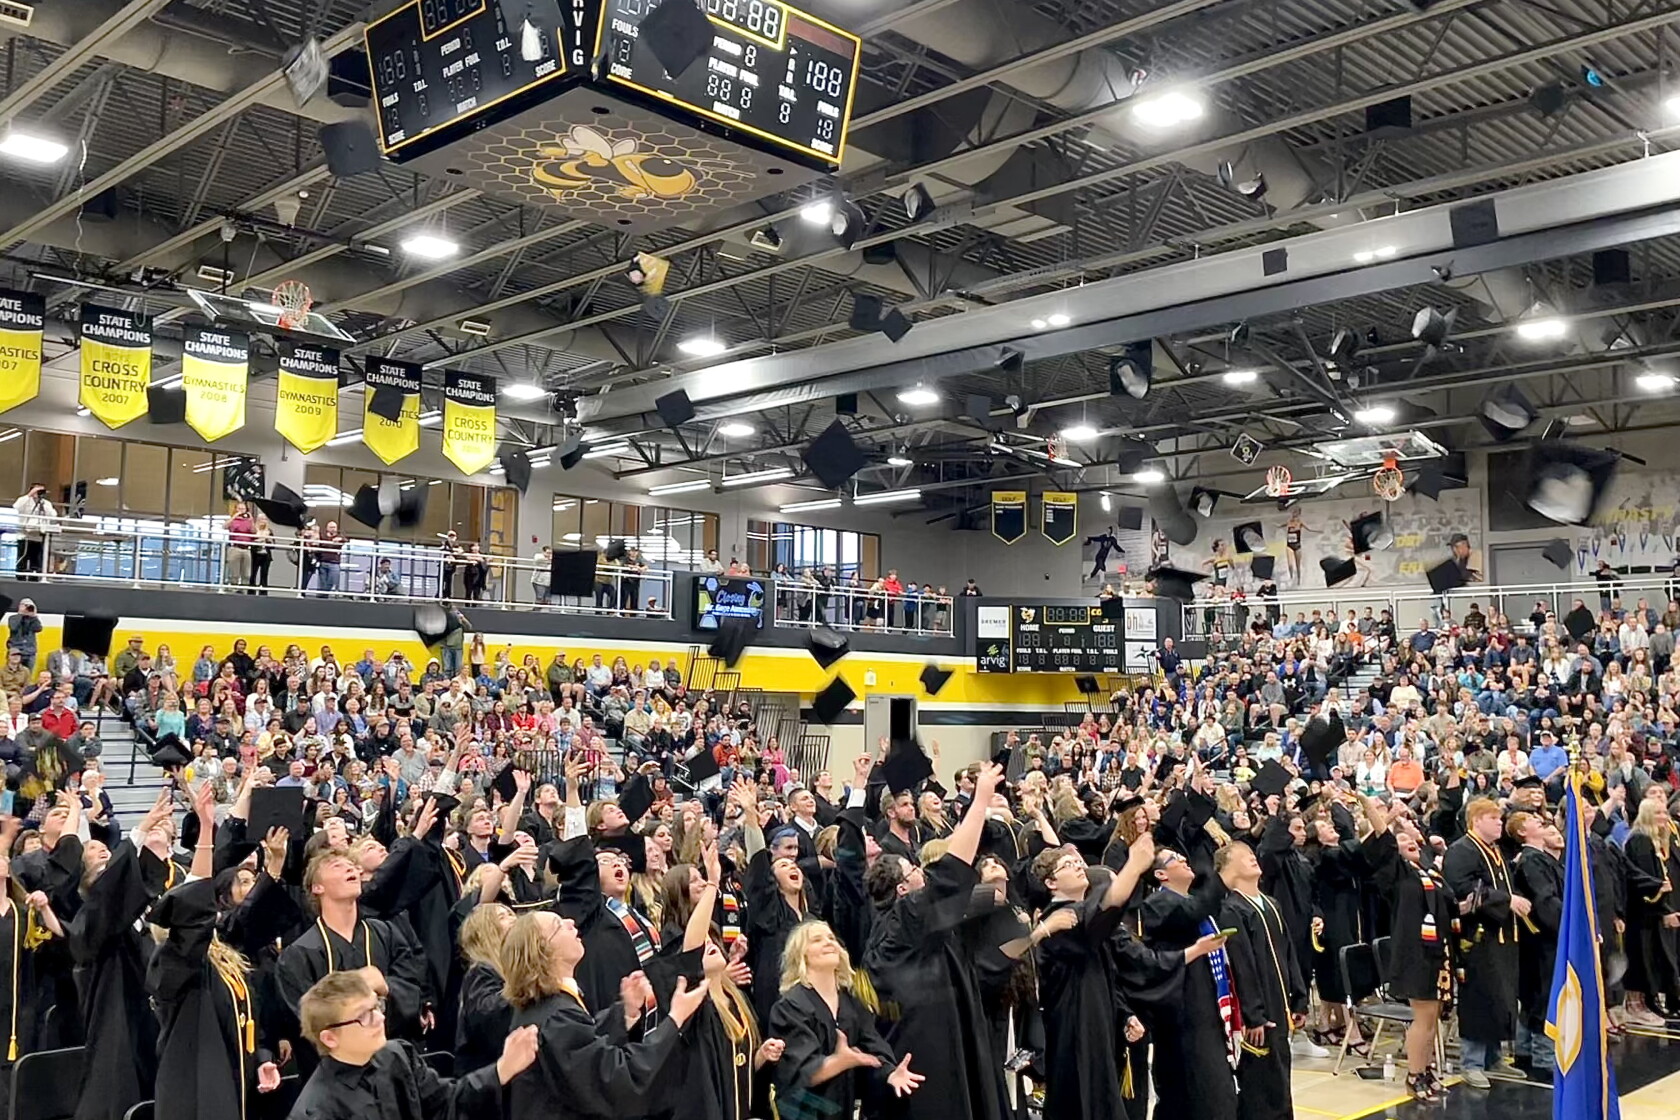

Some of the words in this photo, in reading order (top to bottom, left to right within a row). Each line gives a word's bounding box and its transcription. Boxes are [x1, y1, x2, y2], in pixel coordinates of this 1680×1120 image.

[612, 18, 639, 38] FOULS
[610, 62, 633, 79] CORE
[805, 60, 843, 98] 188
[0, 297, 22, 311] ATE
[99, 314, 132, 329] STATE
[82, 323, 151, 343] CHAMPIONS
[200, 332, 230, 346] STATE
[0, 346, 39, 360] ASTICS
[184, 340, 248, 360] CHAMPIONS
[294, 348, 322, 361] STATE
[93, 360, 138, 377] CROSS
[280, 357, 338, 375] CHAMPIONS
[380, 364, 405, 377] STATE
[84, 374, 146, 393] COUNTRY
[183, 375, 245, 394] GYMNASTICS
[366, 372, 420, 391] CHAMPIONS
[457, 379, 482, 391] STATE
[102, 393, 129, 405] 2007
[280, 390, 337, 407] GYMNASTICS
[445, 387, 495, 403] CHAMPIONS
[295, 404, 322, 416] 2009
[454, 416, 488, 431] CROSS
[447, 428, 493, 445] COUNTRY
[1020, 624, 1040, 632] HOME
[1093, 625, 1116, 633] GUEST
[980, 654, 1006, 668] arvig
